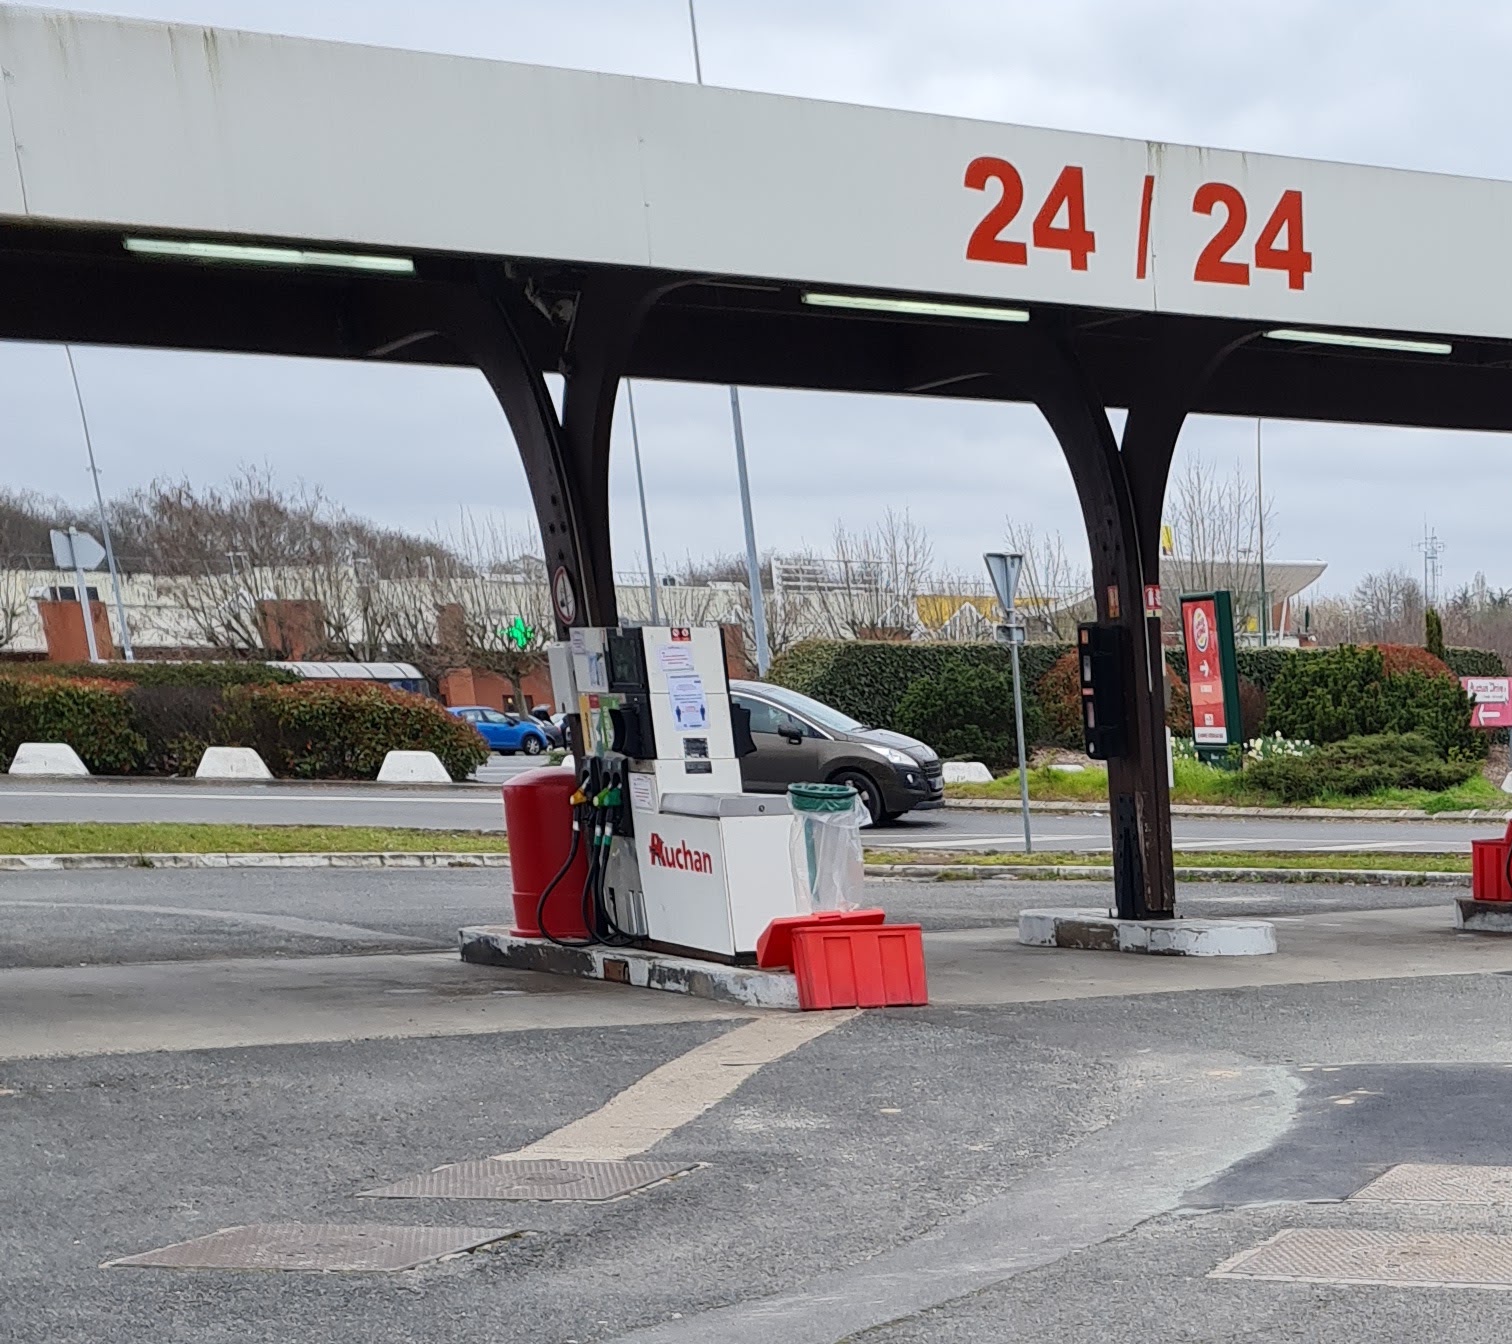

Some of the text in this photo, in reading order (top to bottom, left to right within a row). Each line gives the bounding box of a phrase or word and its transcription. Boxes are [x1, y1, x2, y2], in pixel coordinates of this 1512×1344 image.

[964, 156, 1096, 271] 24
[1192, 182, 1313, 290] 24
[649, 832, 713, 875] Auchan
